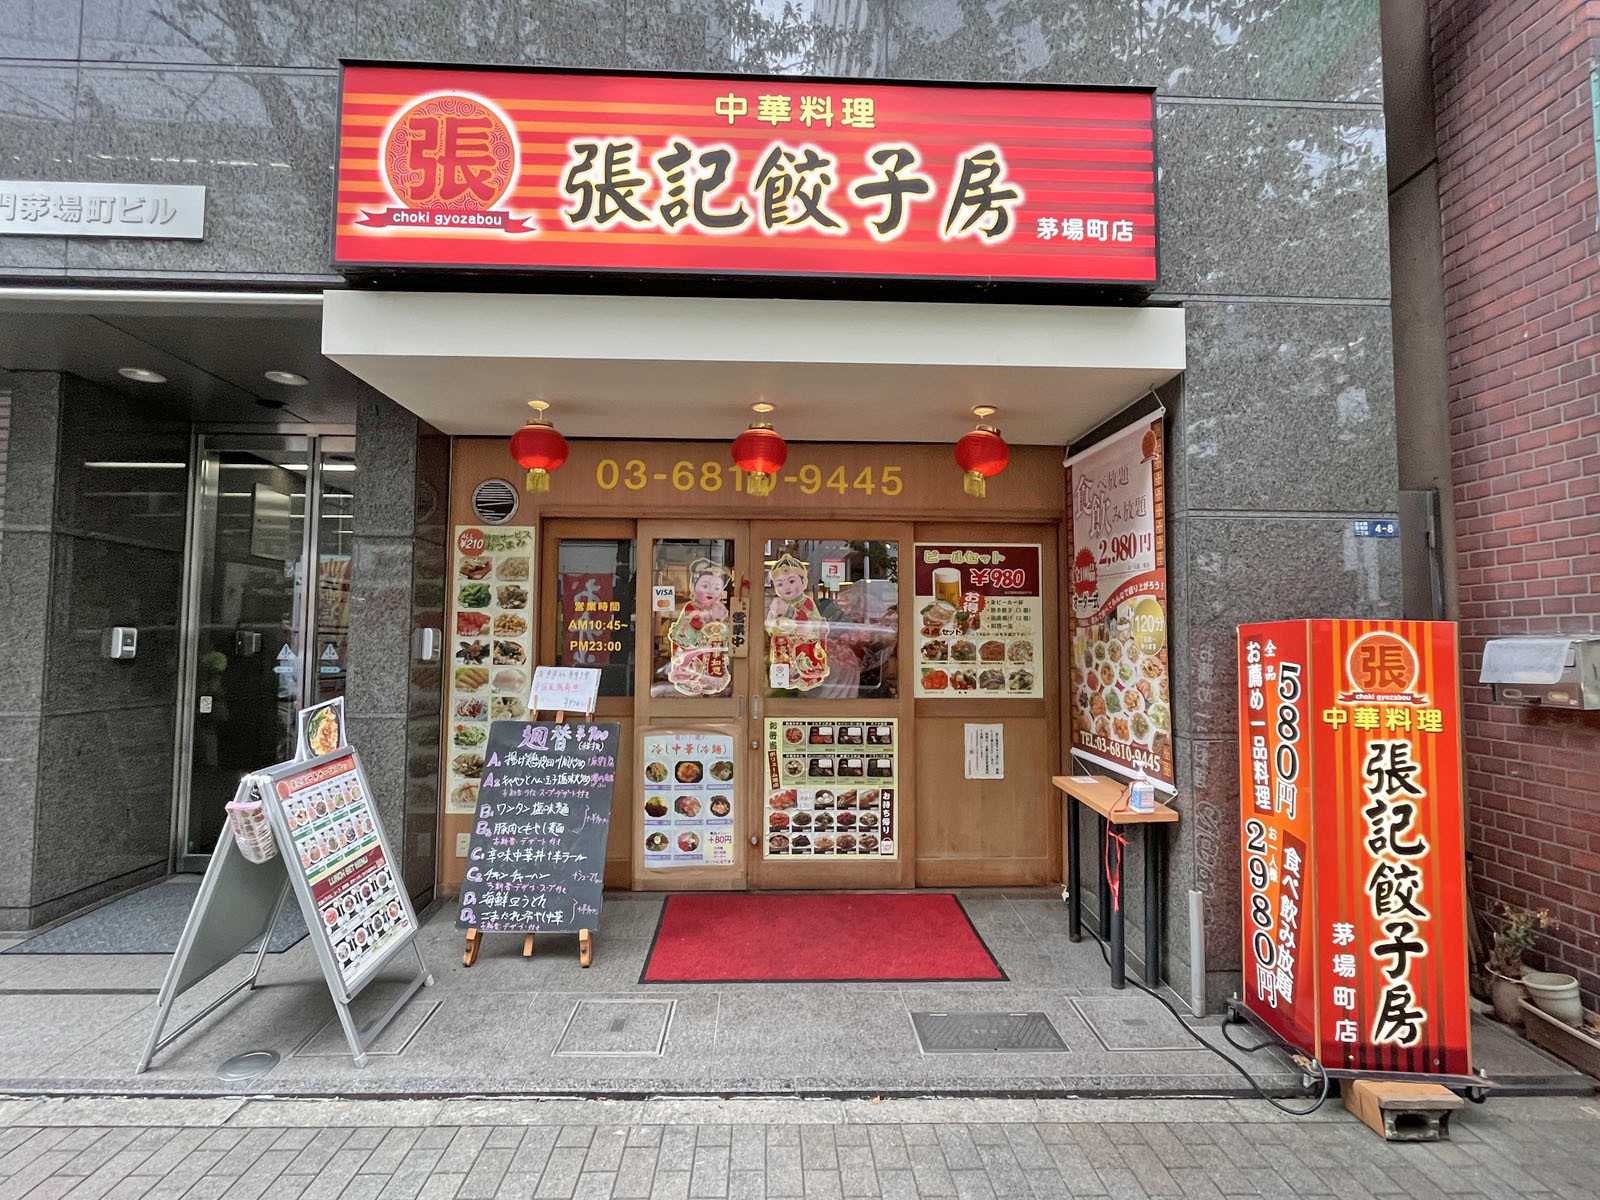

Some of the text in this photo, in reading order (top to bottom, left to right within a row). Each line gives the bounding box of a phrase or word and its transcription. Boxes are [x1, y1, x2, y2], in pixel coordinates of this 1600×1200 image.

[715, 92, 876, 129] 中華料理
[407, 116, 497, 203] 張
[564, 140, 1020, 240] 張記餃子房
[392, 210, 503, 228] choki gyozabou
[1036, 216, 1134, 242] 茅場町店
[596, 457, 904, 496] 03-681-9445
[460, 539, 484, 550] ¥210
[1375, 523, 1393, 533] 4-8
[923, 549, 1006, 565] ビールセット
[1098, 532, 1152, 567] 2,980円
[655, 588, 673, 596] VISA
[969, 567, 1026, 589] ¥980
[1134, 614, 1164, 633] 120分
[569, 640, 622, 652] PM23:00
[1263, 639, 1278, 681] 全品
[1360, 645, 1407, 689] 張
[1355, 692, 1412, 702] choki gyozabou
[1246, 640, 1273, 811] お薦め一品料理
[1322, 706, 1444, 733] 中華料理
[1275, 661, 1302, 820] 580円
[1365, 743, 1429, 1044] 張記餃子房
[1245, 818, 1277, 1009] 2980円
[1275, 847, 1302, 1004] 食べ飲み放題
[1331, 922, 1358, 1044] 茅場町店
